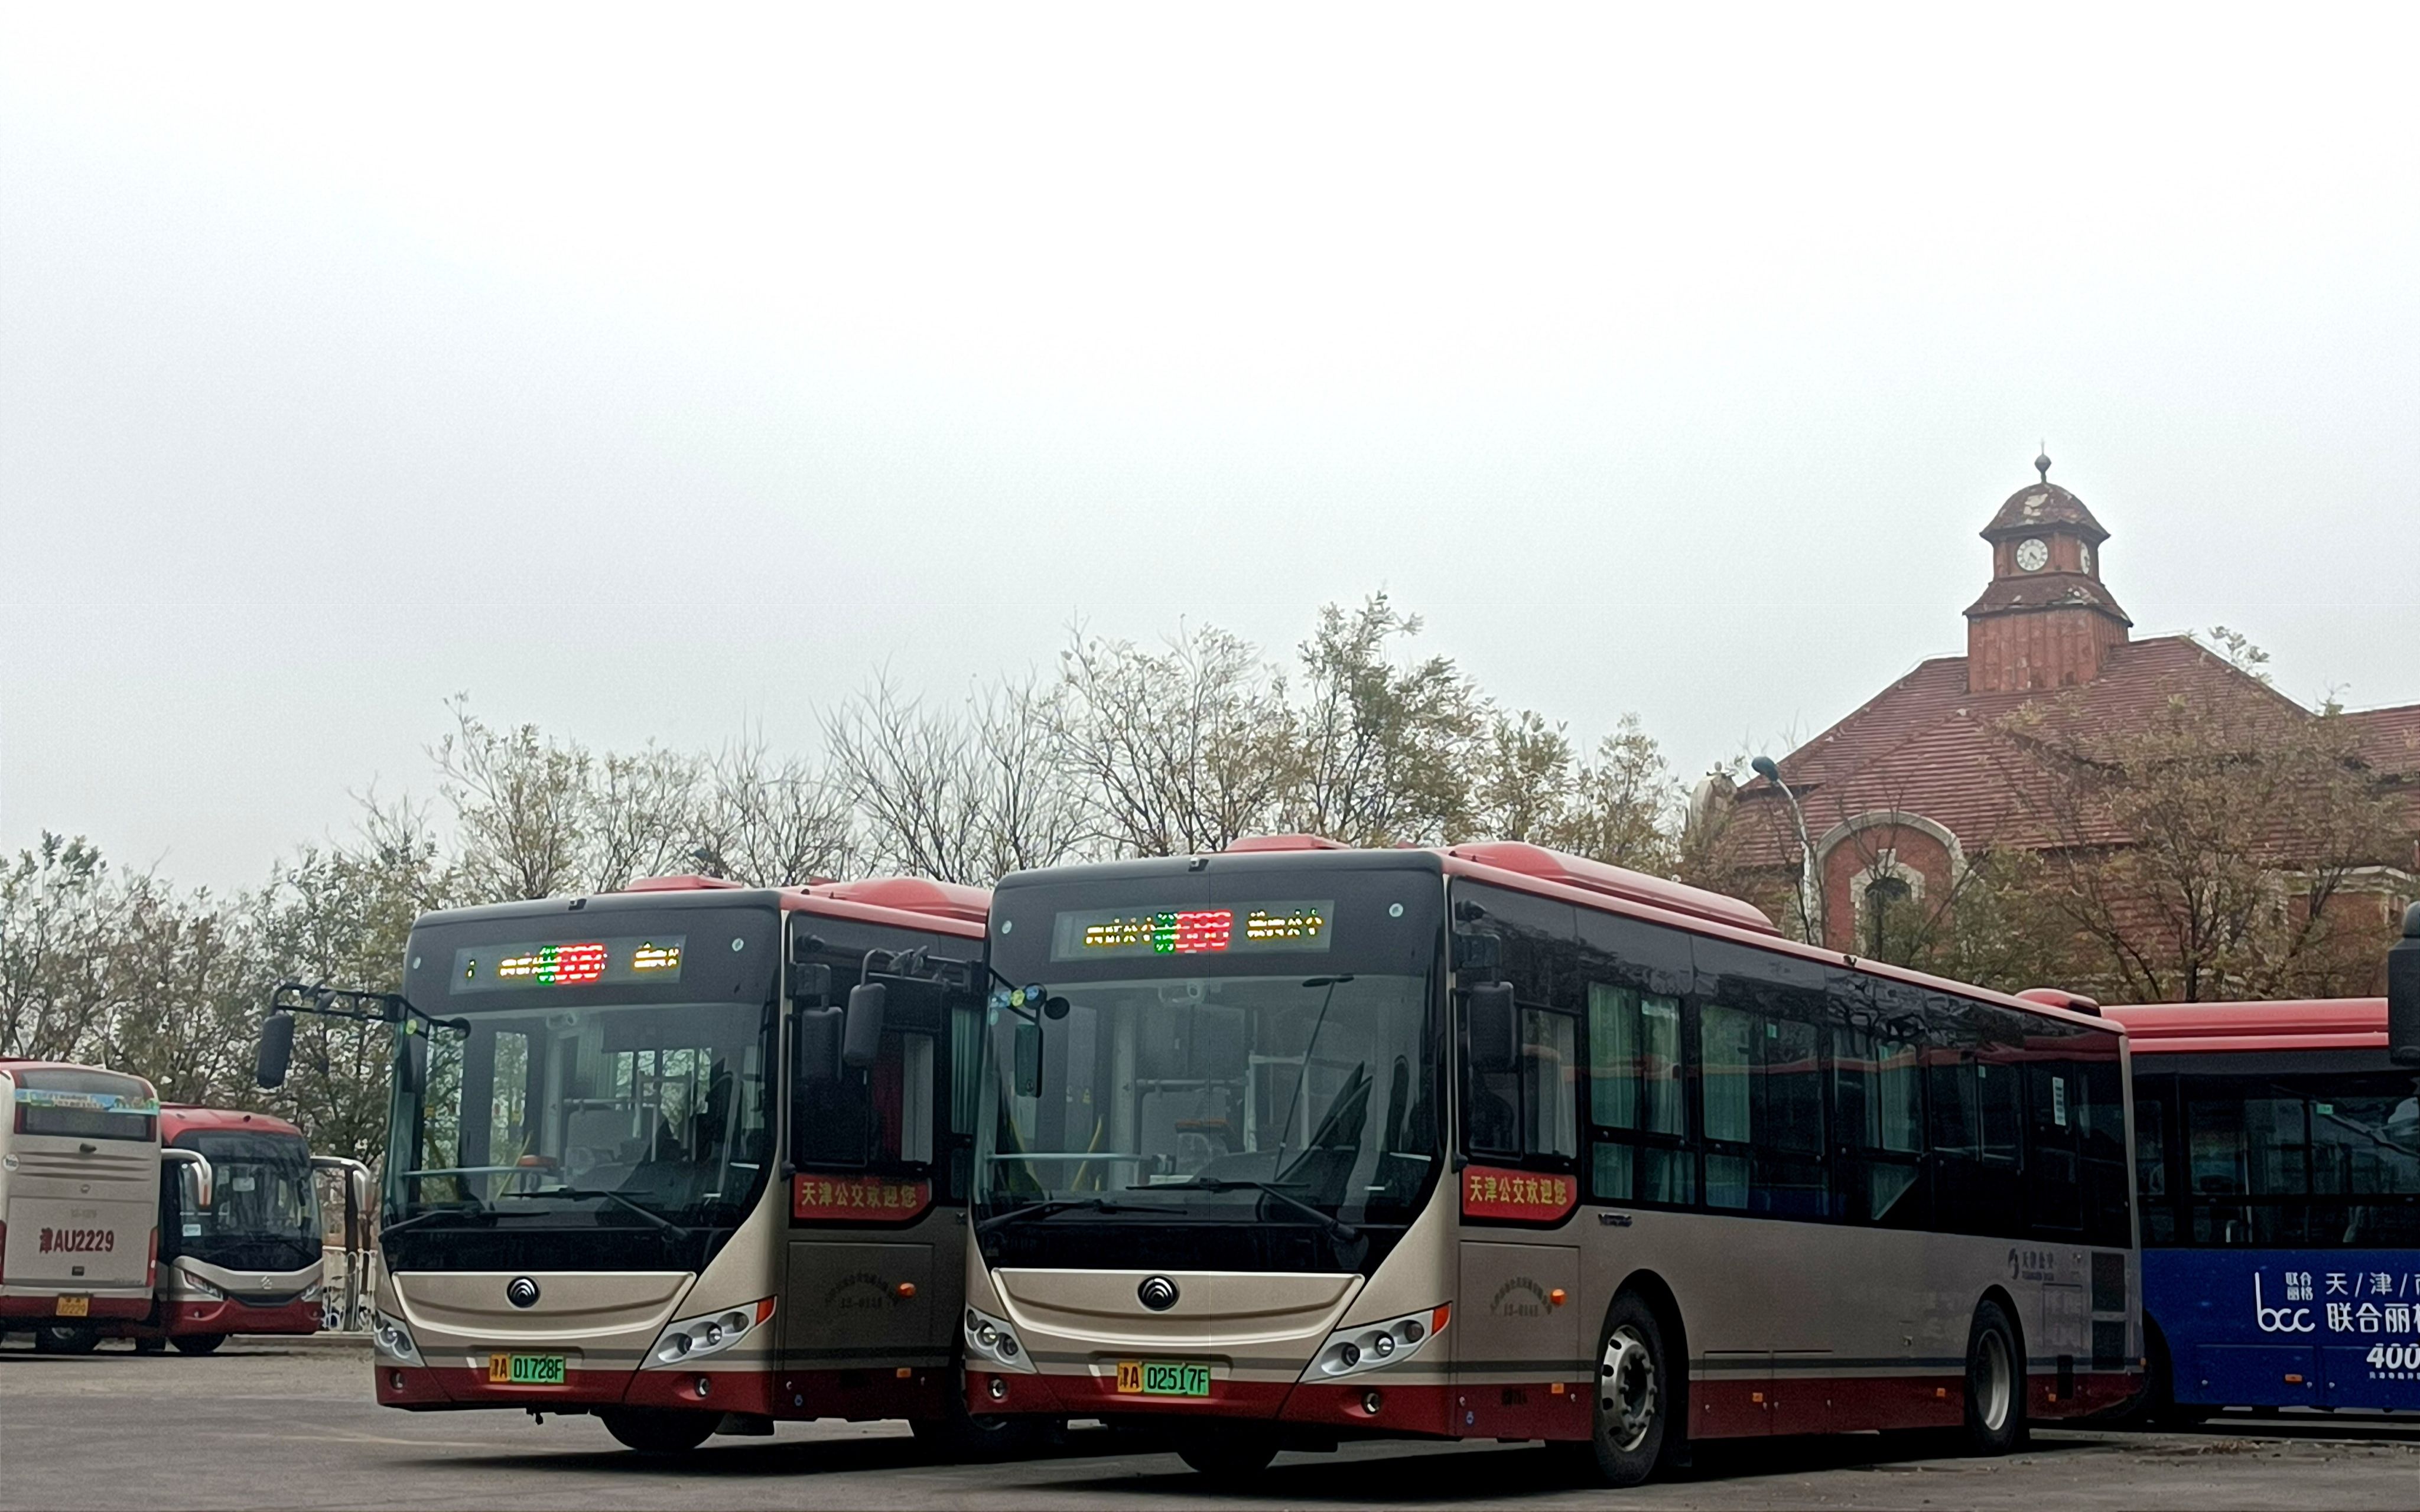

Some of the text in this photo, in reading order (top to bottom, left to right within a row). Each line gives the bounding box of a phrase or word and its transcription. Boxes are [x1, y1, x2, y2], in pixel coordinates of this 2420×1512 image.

[801, 1182, 918, 1208] 天津公交欢迎您
[1470, 1175, 1567, 1205] 天津公交欢迎您
